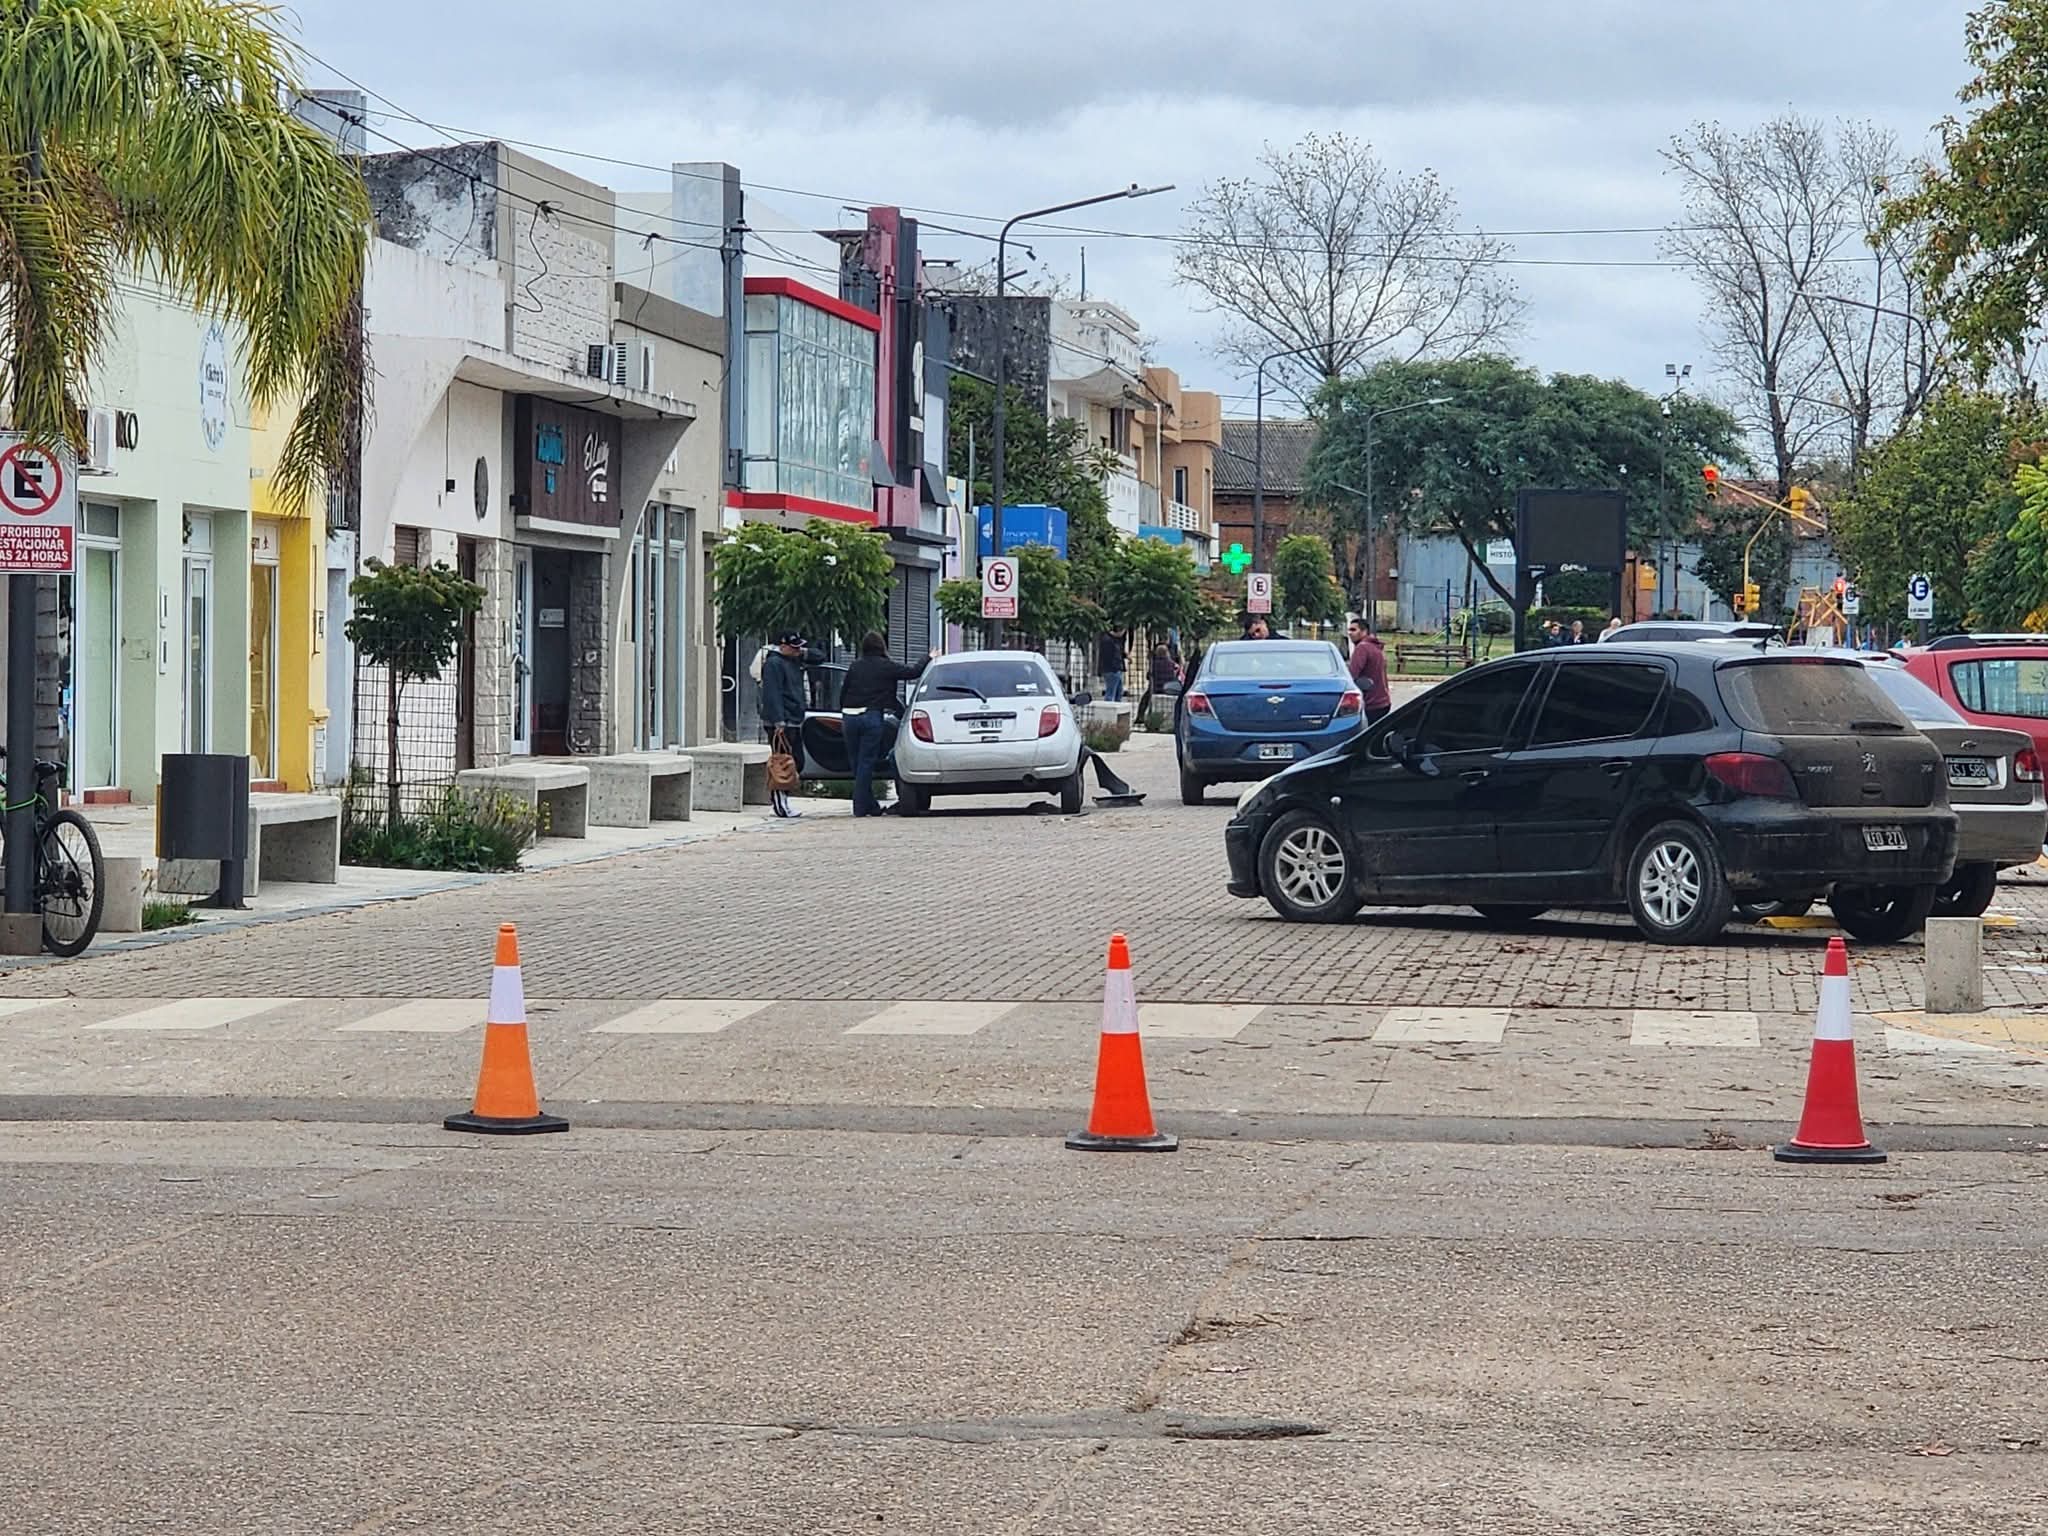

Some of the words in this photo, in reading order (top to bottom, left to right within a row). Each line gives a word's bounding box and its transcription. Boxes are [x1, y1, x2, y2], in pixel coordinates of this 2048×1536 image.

[1, 526, 60, 538] PROHIBIDO
[0, 550, 13, 561] AS
[15, 550, 28, 561] 24
[31, 551, 68, 562] HORAS
[1915, 581, 1926, 597] E
